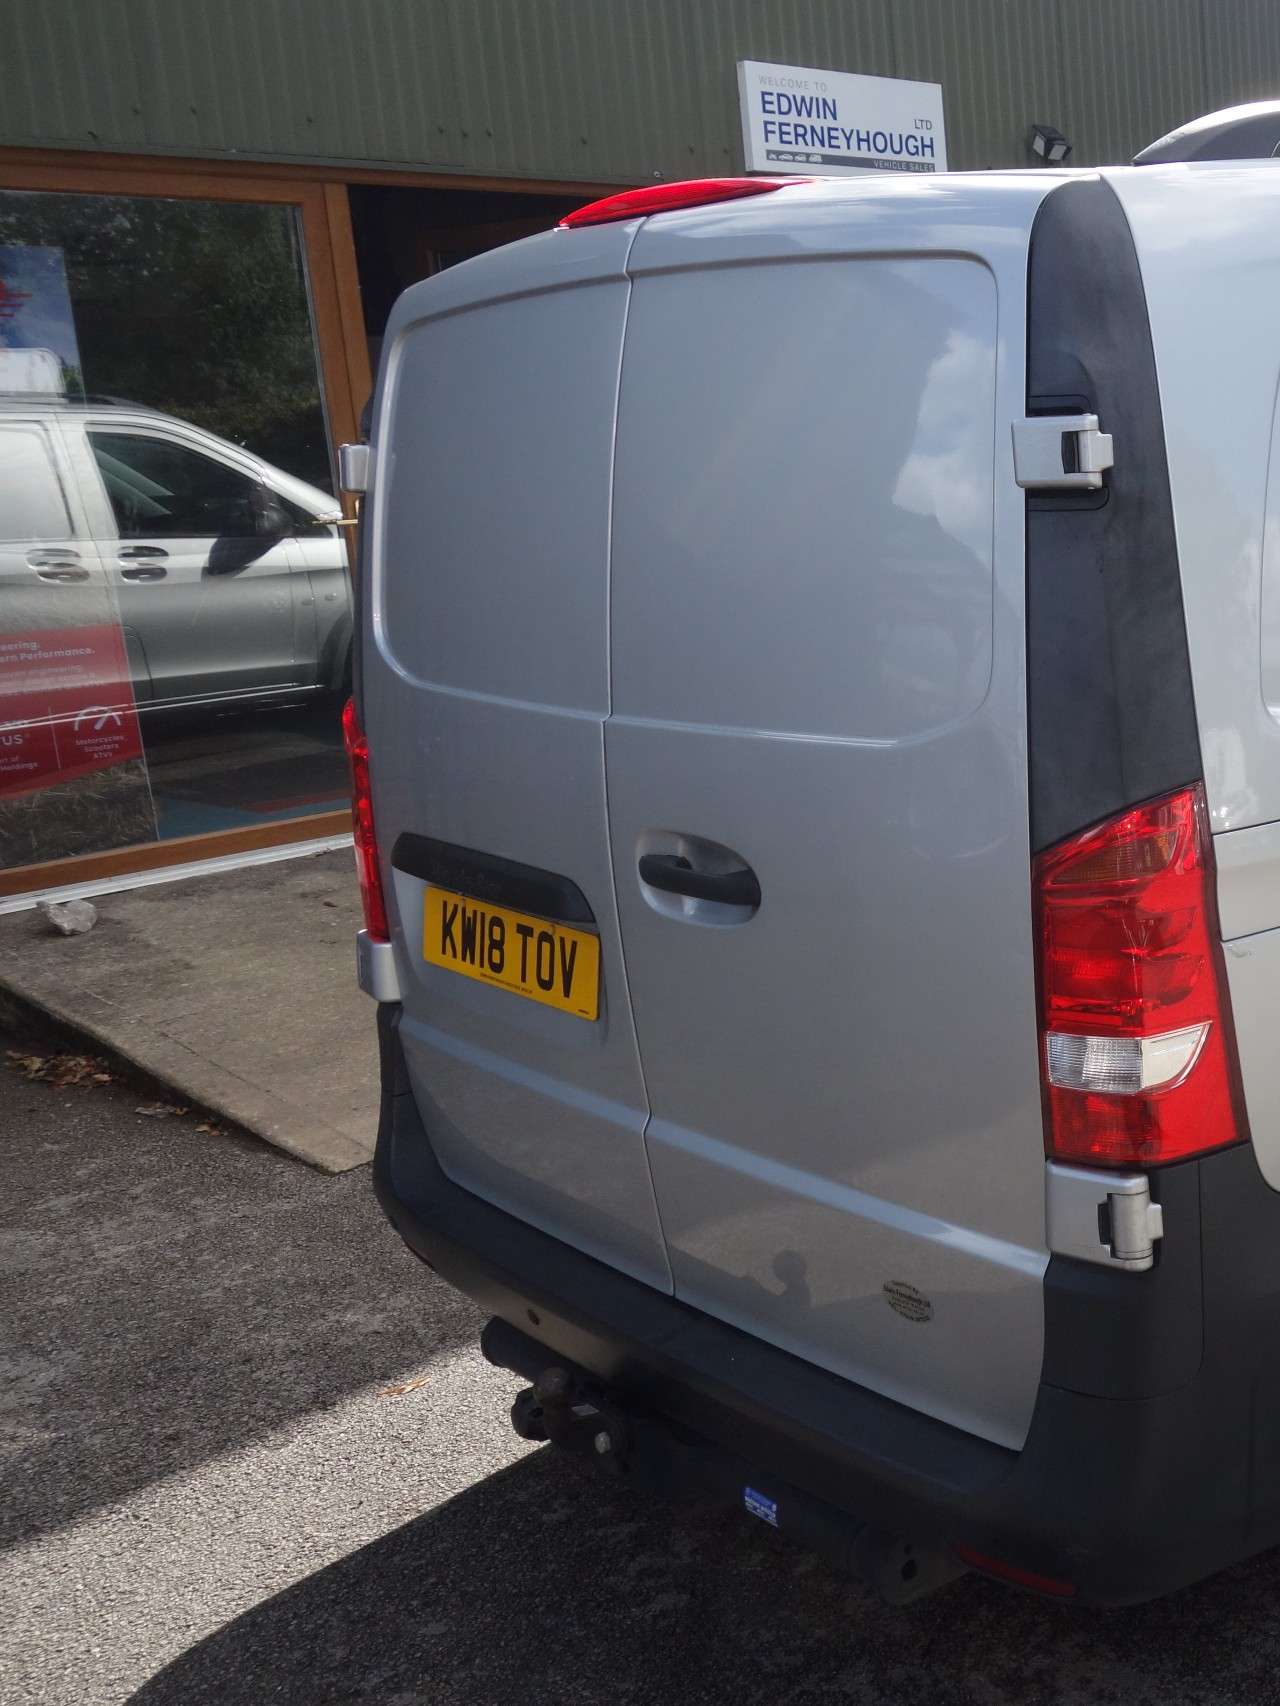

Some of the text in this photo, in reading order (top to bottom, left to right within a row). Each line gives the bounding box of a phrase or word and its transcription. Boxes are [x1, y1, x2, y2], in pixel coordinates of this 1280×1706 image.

[758, 75, 828, 93] WELCOME TO
[760, 90, 838, 121] EDWIN
[913, 118, 933, 130] LTD
[762, 120, 935, 158] FERNEYHOUGH
[873, 159, 907, 170] VEHICLE
[441, 900, 578, 999] KW18 TOV
